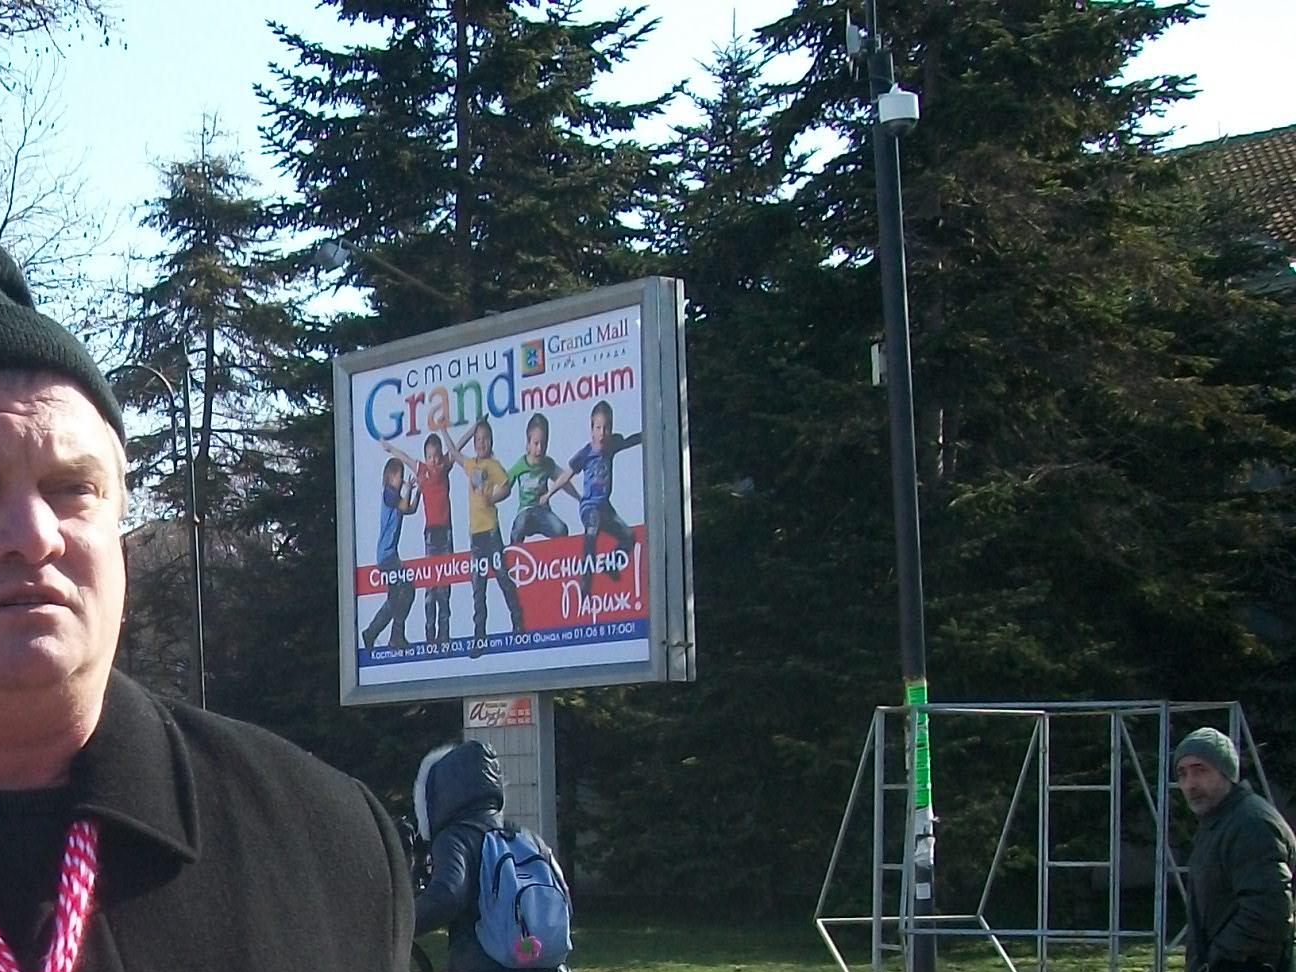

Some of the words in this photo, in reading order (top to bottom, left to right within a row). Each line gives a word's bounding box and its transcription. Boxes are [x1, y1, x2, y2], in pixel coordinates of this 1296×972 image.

[547, 327, 593, 354] Grand
[597, 318, 629, 344] Mall
[406, 350, 497, 389] стани
[521, 366, 634, 412] талант
[365, 349, 520, 442] Grand
[370, 565, 431, 587] Спечели
[435, 557, 489, 582] уикенд
